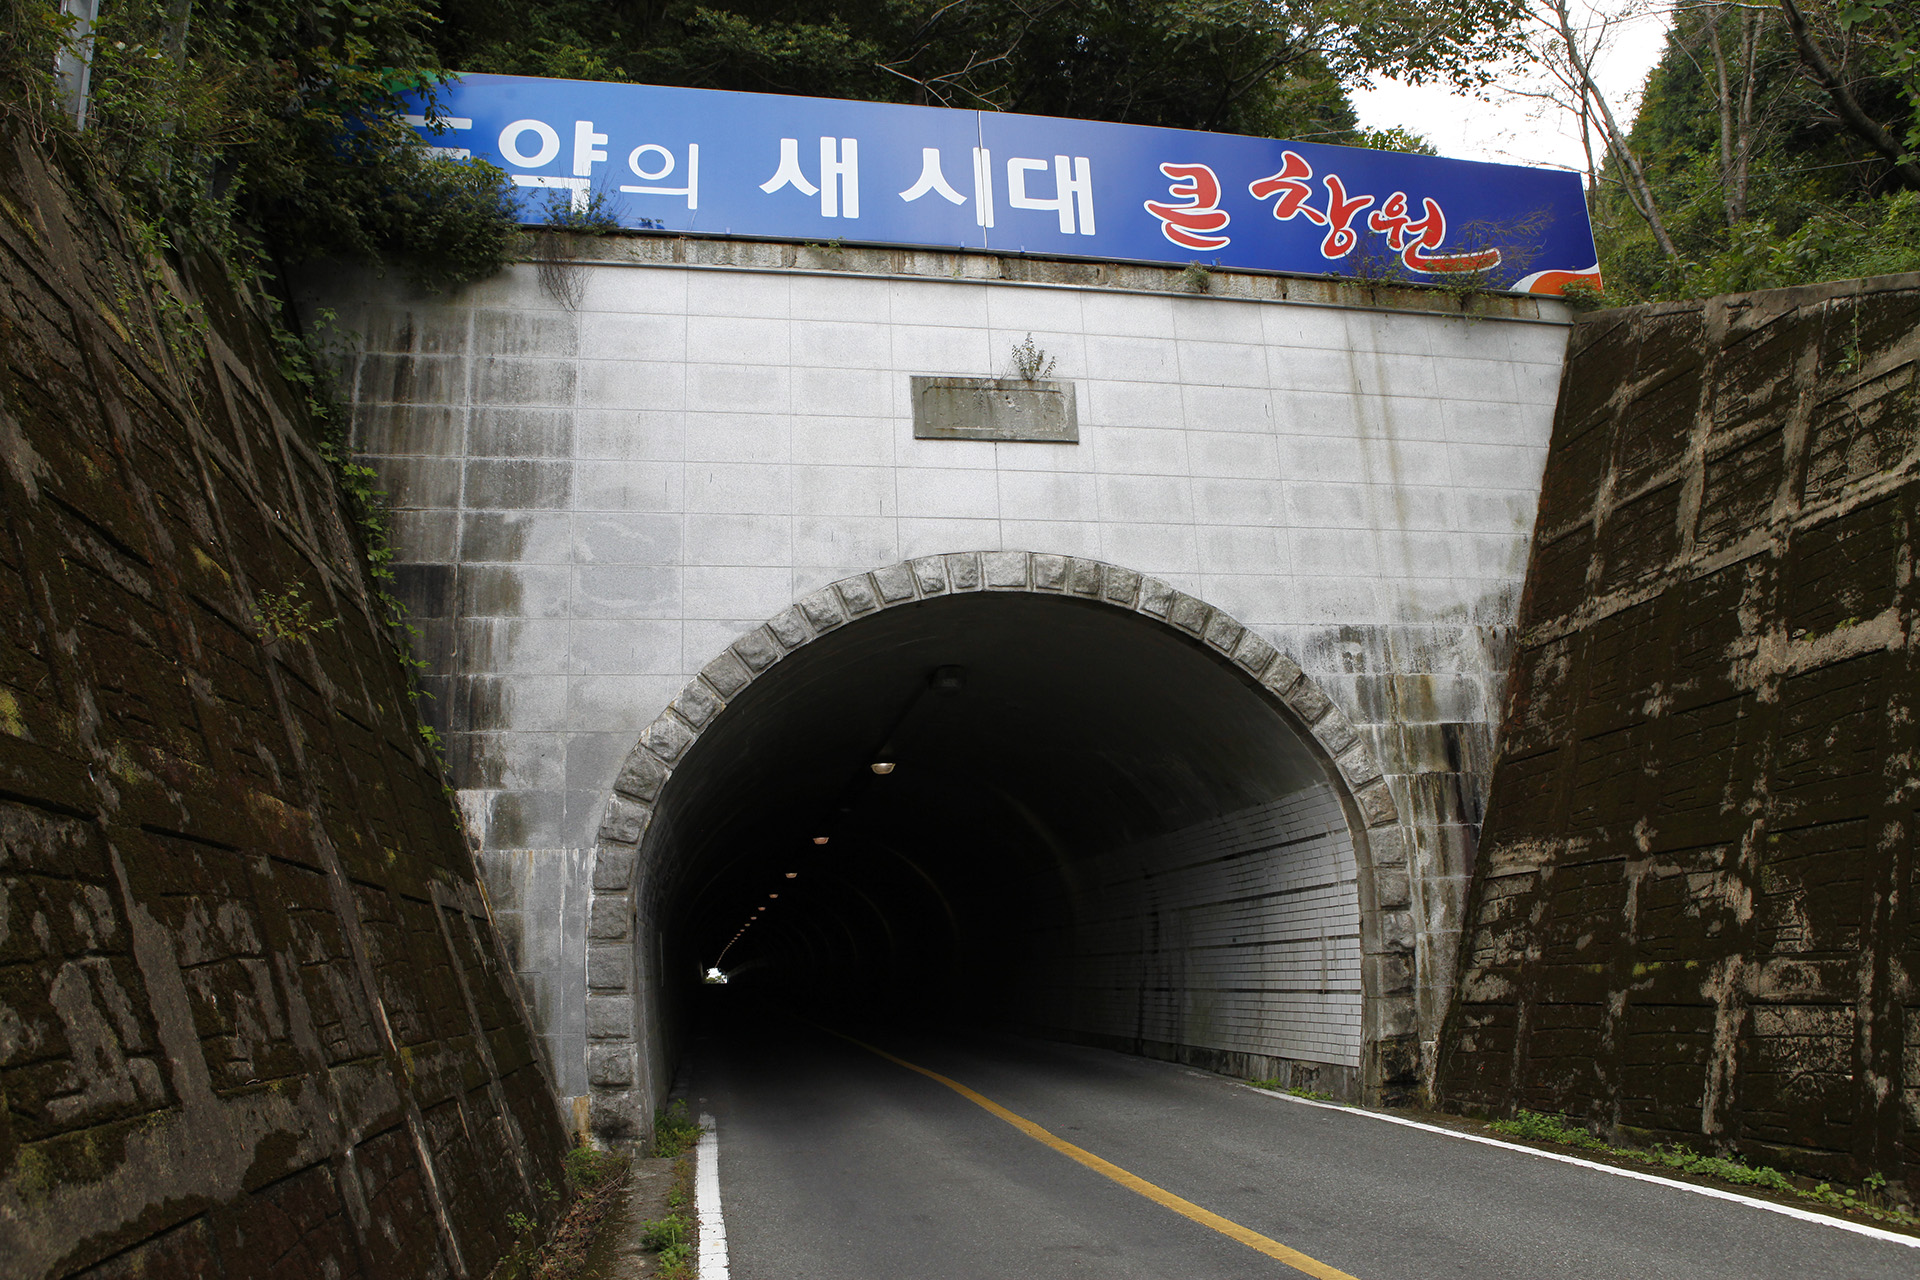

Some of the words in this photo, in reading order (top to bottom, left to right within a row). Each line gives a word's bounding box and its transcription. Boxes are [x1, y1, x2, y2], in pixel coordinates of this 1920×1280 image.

[759, 136, 859, 218] 새
[898, 147, 1096, 235] 시대
[1144, 162, 1231, 251] 큰
[1248, 150, 1501, 274] 창원
